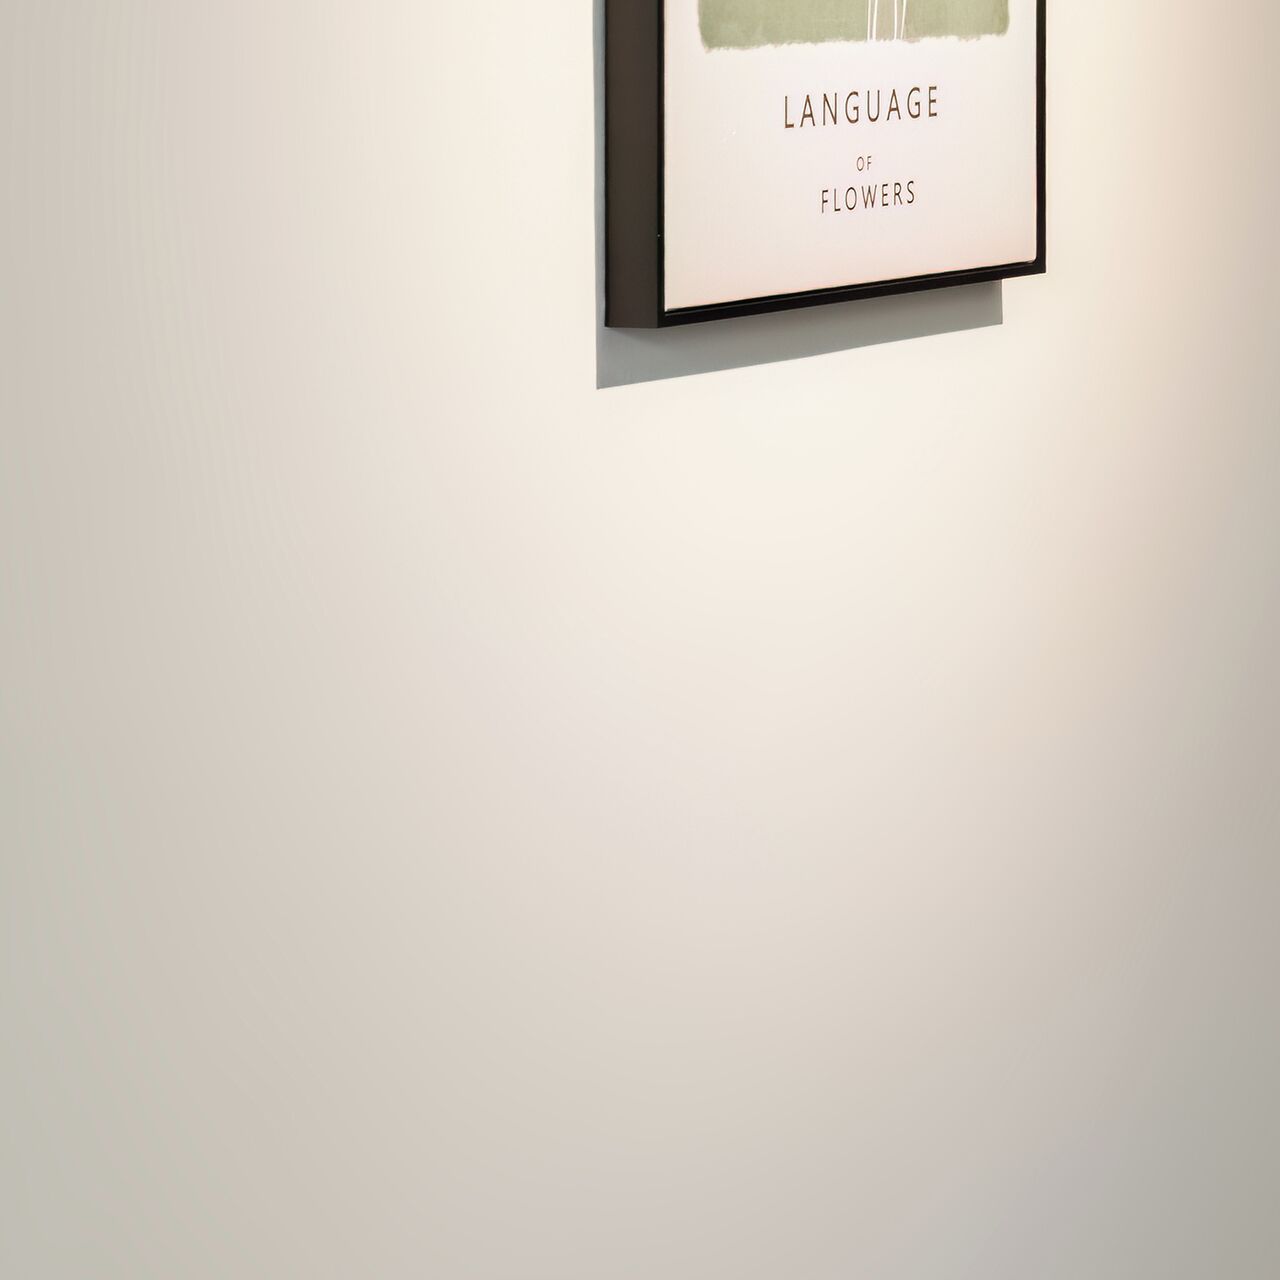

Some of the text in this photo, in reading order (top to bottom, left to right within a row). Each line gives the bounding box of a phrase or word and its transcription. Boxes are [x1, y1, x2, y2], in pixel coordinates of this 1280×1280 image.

[784, 85, 938, 129] LANGUAGE
[856, 155, 872, 172] OF
[821, 180, 915, 214] FLOWERS
